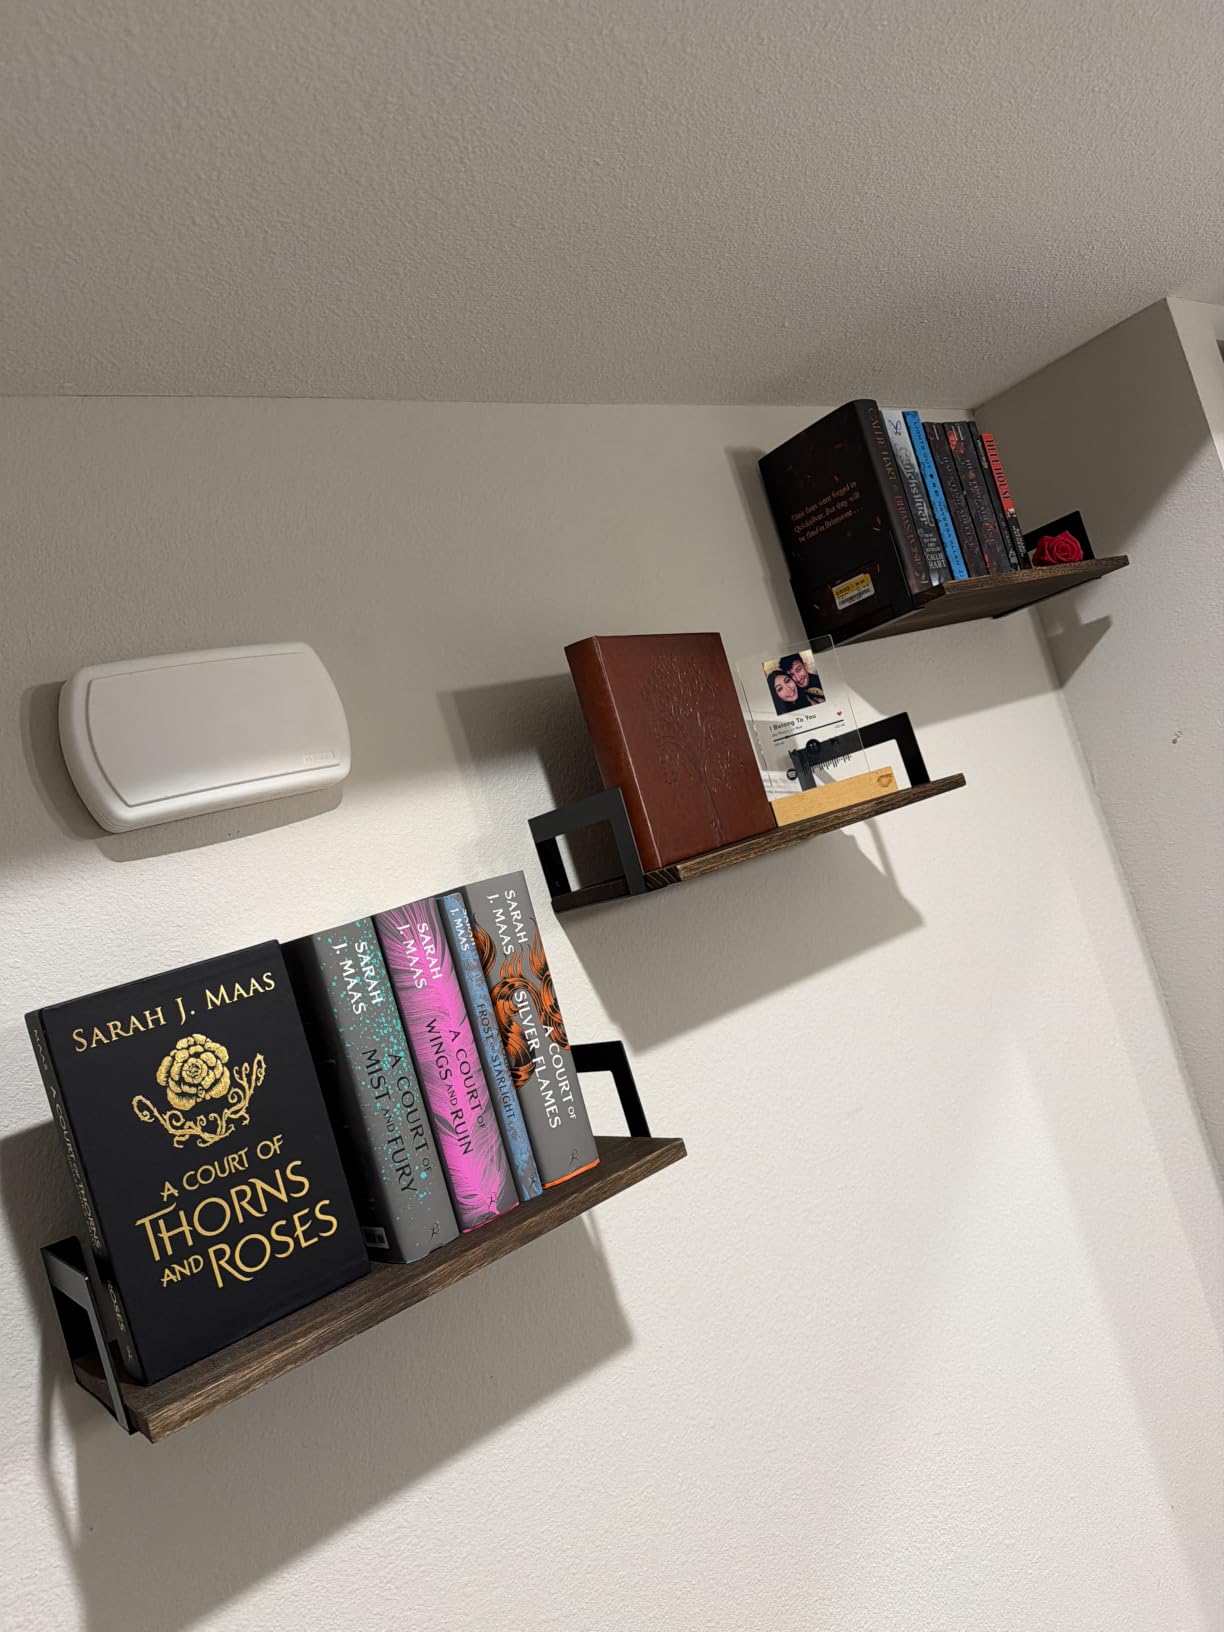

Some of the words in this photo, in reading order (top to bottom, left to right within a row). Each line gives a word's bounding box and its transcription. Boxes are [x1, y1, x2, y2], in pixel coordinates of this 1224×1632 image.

[913, 420, 925, 450] LIGHTS
[922, 452, 931, 469] OUT
[893, 443, 935, 527] Quicksilver
[993, 467, 1012, 501] HOUSE
[926, 552, 945, 561] CALLIE
[928, 560, 946, 569] HART
[773, 720, 795, 731] Belong
[452, 907, 459, 916] J.
[486, 893, 500, 906] J.
[504, 889, 529, 945] SARAH
[331, 941, 348, 957] J.
[396, 922, 412, 937] J.
[416, 922, 443, 980] SARAH
[453, 918, 470, 951] MAAS
[491, 908, 516, 957] MAAS
[339, 958, 367, 1016] MAAS
[355, 940, 384, 1006] SARAH
[402, 939, 428, 989] MAAS
[72, 1006, 168, 1053] SARAH
[174, 997, 197, 1026] J.
[205, 972, 277, 1011] MAAS
[447, 1028, 460, 1043] A
[542, 1024, 553, 1038] A
[424, 1016, 453, 1083] WINGS
[477, 1003, 493, 1041] FROST
[491, 1054, 516, 1119] STARLIGHT
[513, 988, 538, 1054] SILVER
[531, 1056, 562, 1130] FLAMES
[547, 1041, 575, 1104] COURT
[361, 1048, 392, 1104] MIST
[445, 1083, 459, 1107] AND
[453, 1046, 484, 1112] COURT
[381, 1106, 397, 1134] AND
[387, 1051, 402, 1069] A
[396, 1070, 430, 1153] COURT
[422, 1156, 434, 1173] OF
[449, 1107, 474, 1156] RUIN
[476, 1114, 487, 1129] OF
[567, 1105, 577, 1120] OF
[33, 1028, 49, 1071] MAAS
[50, 1085, 58, 1099] A
[55, 1103, 76, 1162] COURT
[76, 1179, 102, 1249] THORNS
[161, 1181, 179, 1202] A
[182, 1147, 250, 1192] COURT
[257, 1134, 284, 1161] OF
[386, 1134, 418, 1195] FURY
[135, 1160, 311, 1263] THORNS
[161, 1256, 205, 1288] AND
[208, 1198, 339, 1290] ROSES
